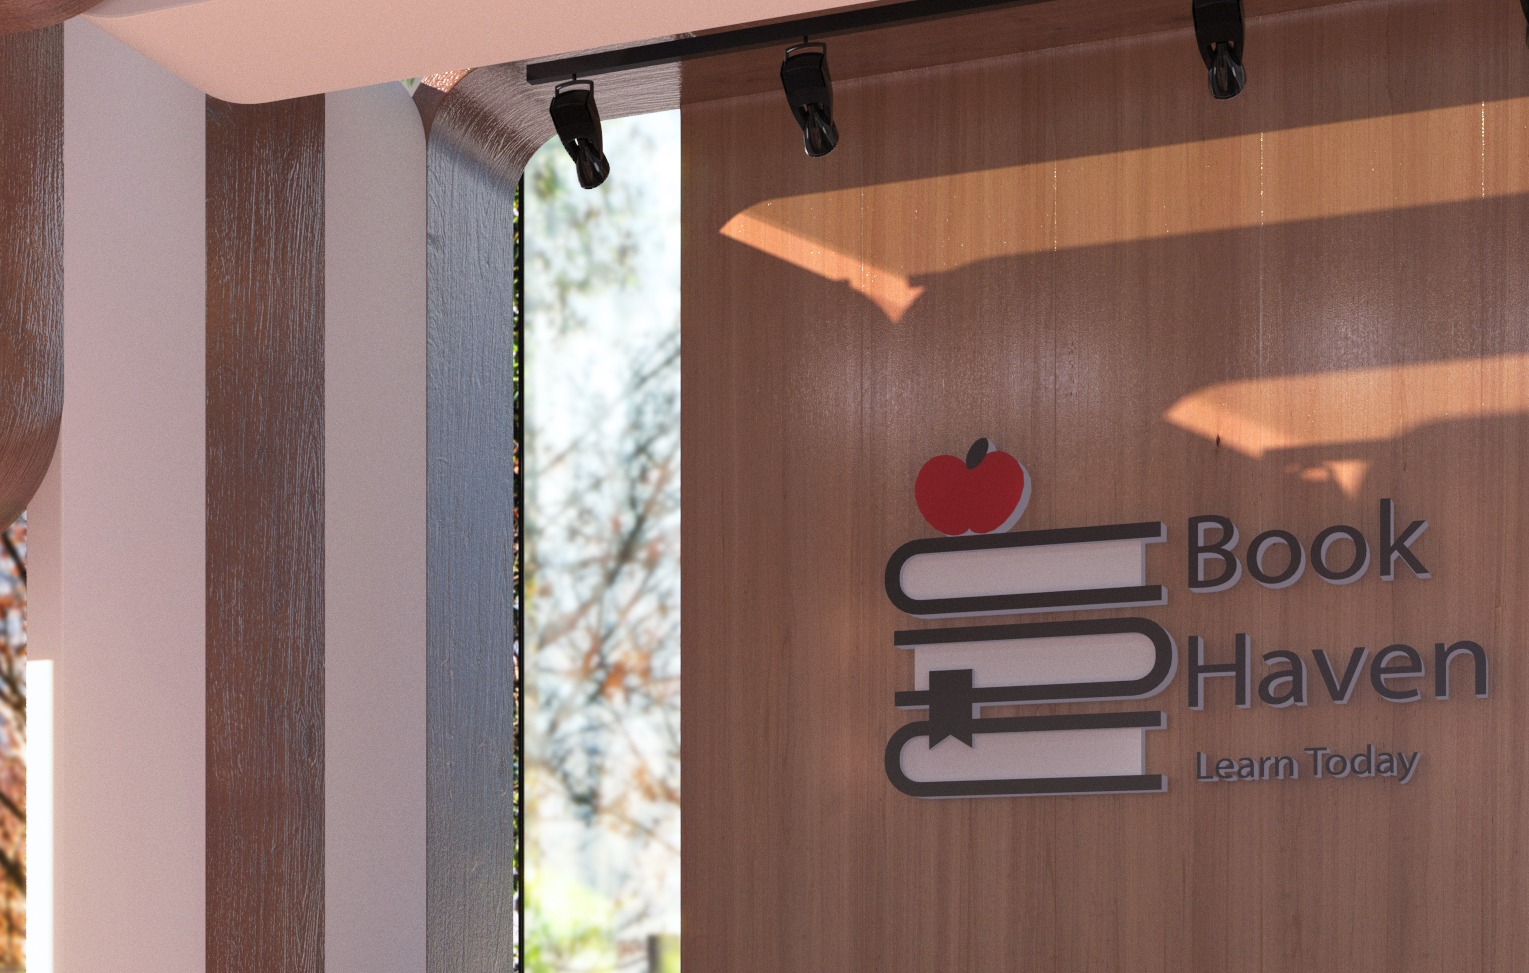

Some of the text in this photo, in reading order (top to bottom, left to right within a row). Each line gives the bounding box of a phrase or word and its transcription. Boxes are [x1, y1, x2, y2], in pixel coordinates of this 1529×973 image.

[1187, 498, 1430, 592] Book
[1187, 632, 1488, 710] Haven
[1196, 743, 1421, 785] Learn Today
